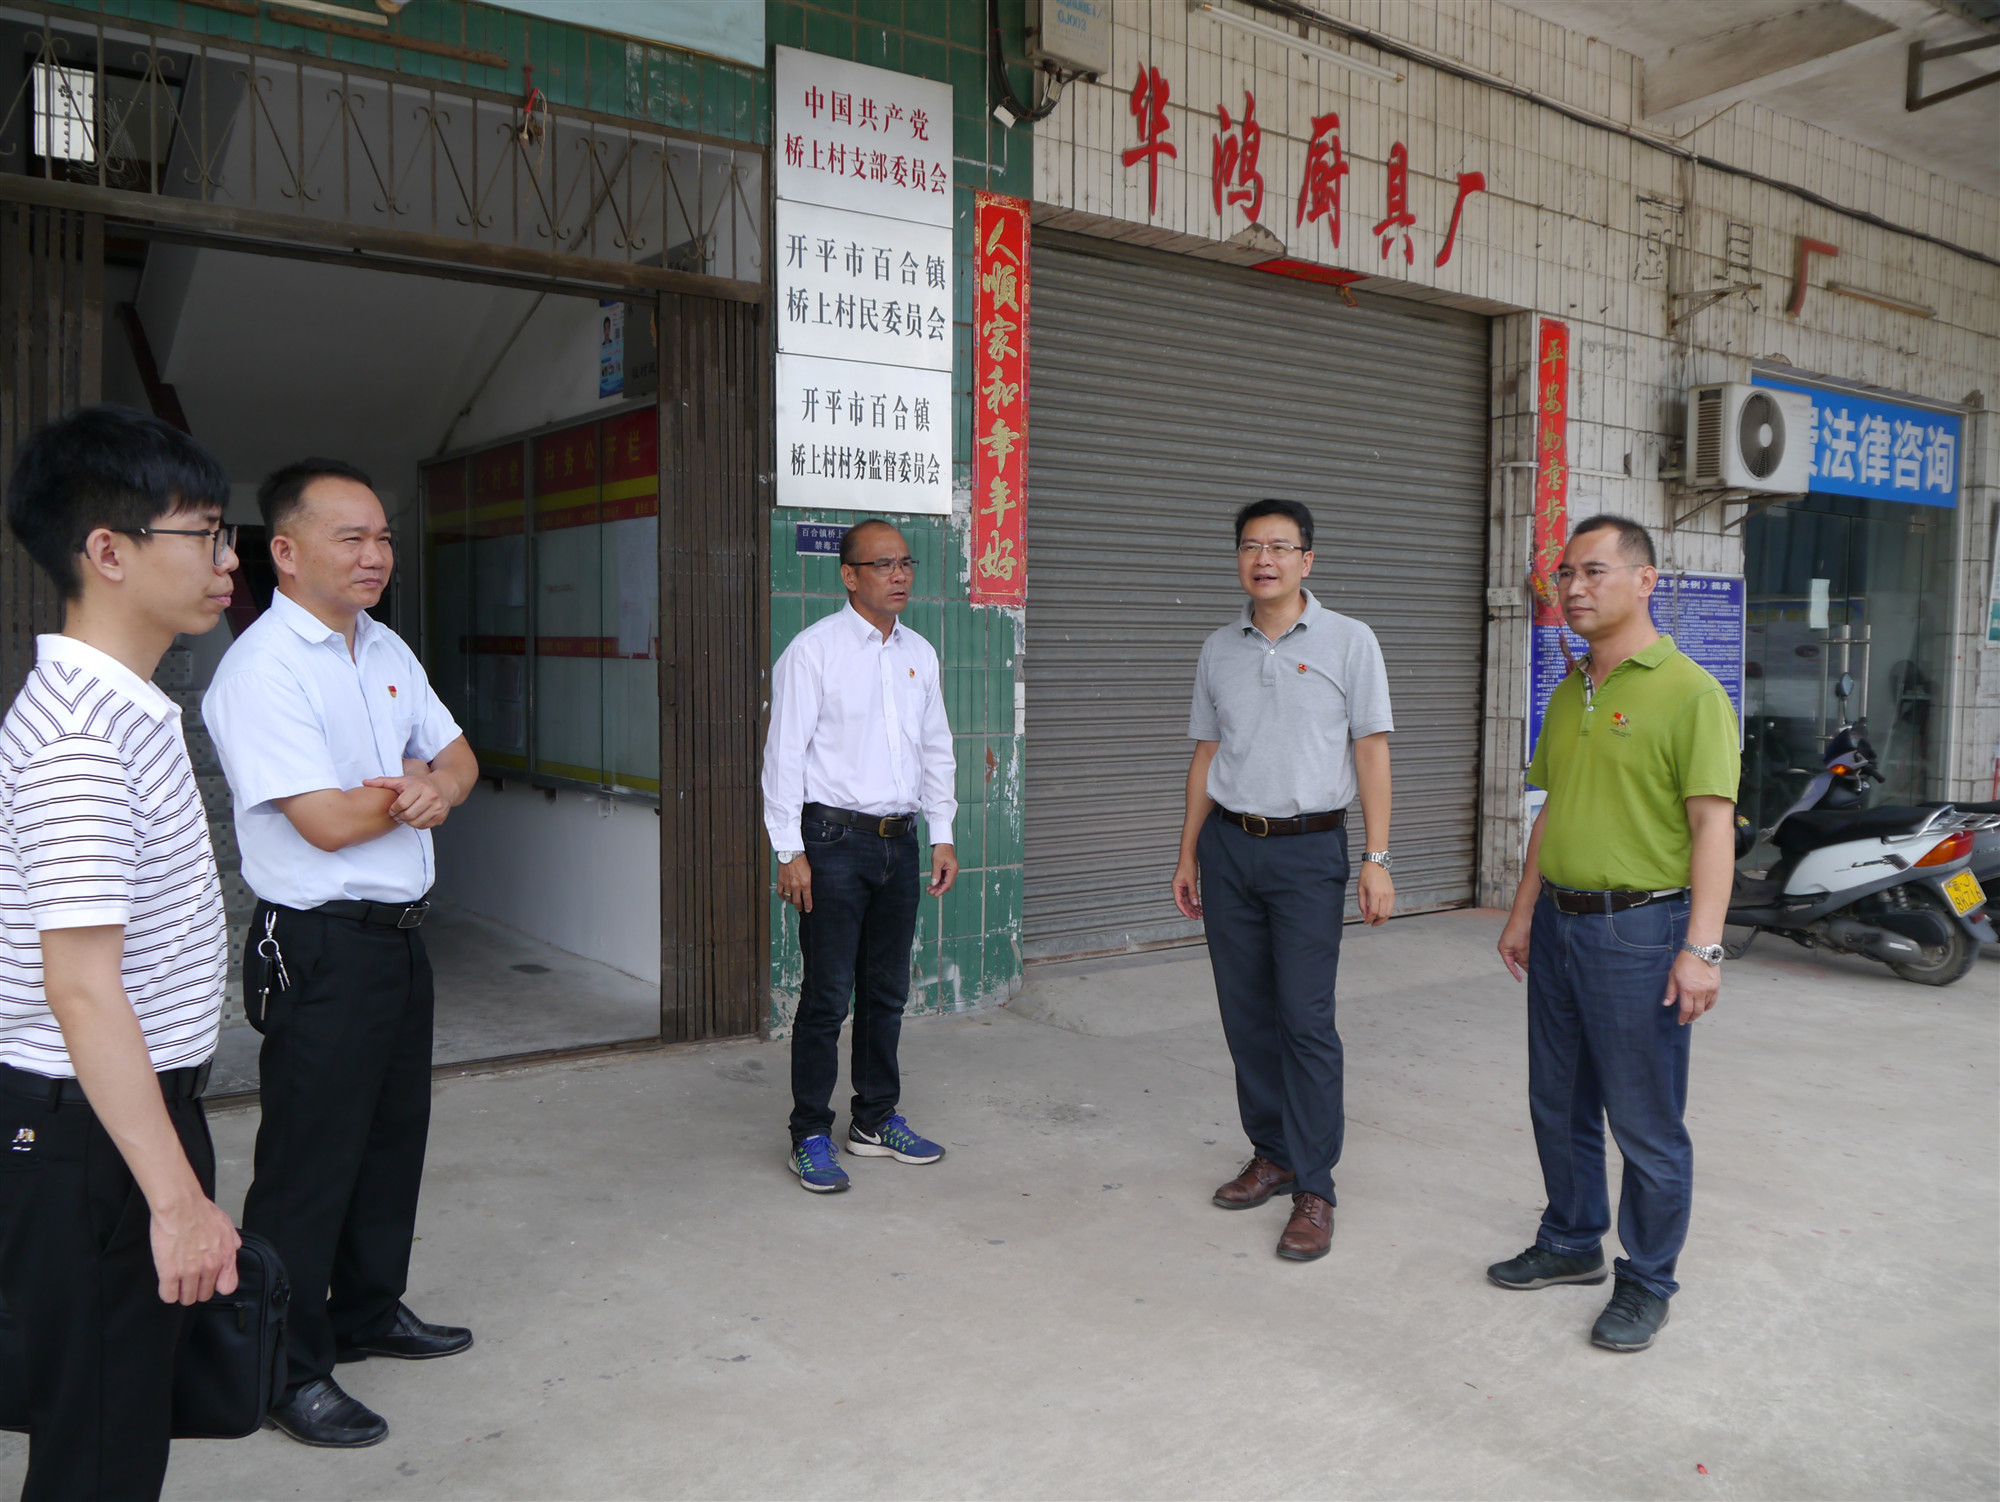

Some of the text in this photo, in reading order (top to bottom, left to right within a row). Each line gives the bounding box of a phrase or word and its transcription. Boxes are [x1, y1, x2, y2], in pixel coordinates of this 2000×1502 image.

[804, 85, 929, 141] 中国共产党
[784, 132, 947, 195] 桥上村支部委员会
[1122, 62, 1486, 268] 华鸿厨具厂
[786, 233, 946, 290] 开平市百合镇
[786, 286, 946, 341] 桥上村民委员会
[801, 386, 930, 432] 开平市百合镇
[790, 442, 940, 485] 桥上村村务监督委员会
